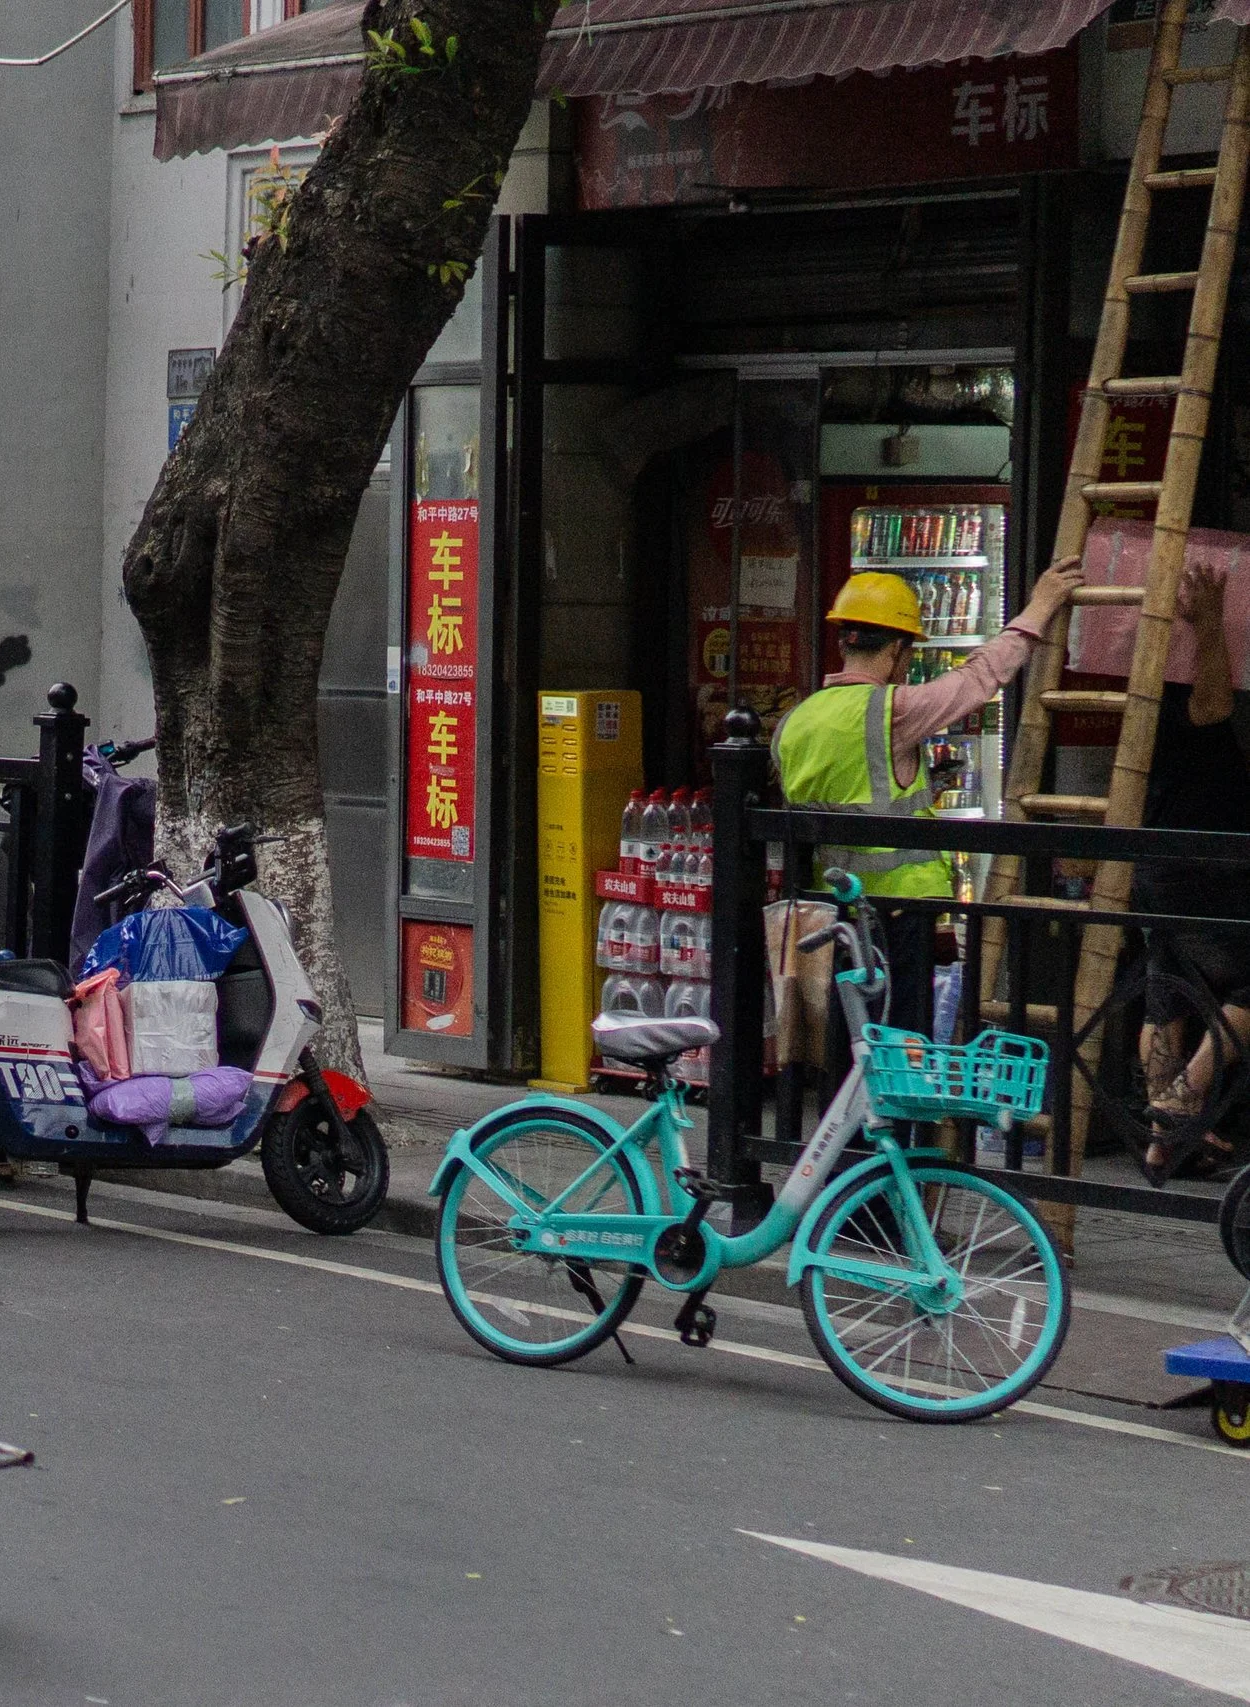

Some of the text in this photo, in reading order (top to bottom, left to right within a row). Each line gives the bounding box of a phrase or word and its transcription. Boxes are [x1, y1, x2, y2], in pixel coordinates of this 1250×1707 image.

[951, 75, 1049, 146] 车标
[417, 506, 479, 523] 和平中路27号
[427, 530, 464, 655] 车标
[418, 664, 474, 677] 18320423855
[416, 688, 472, 706] 和平中路27号
[425, 710, 459, 829] 车标
[604, 878, 637, 895] 农夫山泉
[662, 891, 696, 907] 农夫山泉
